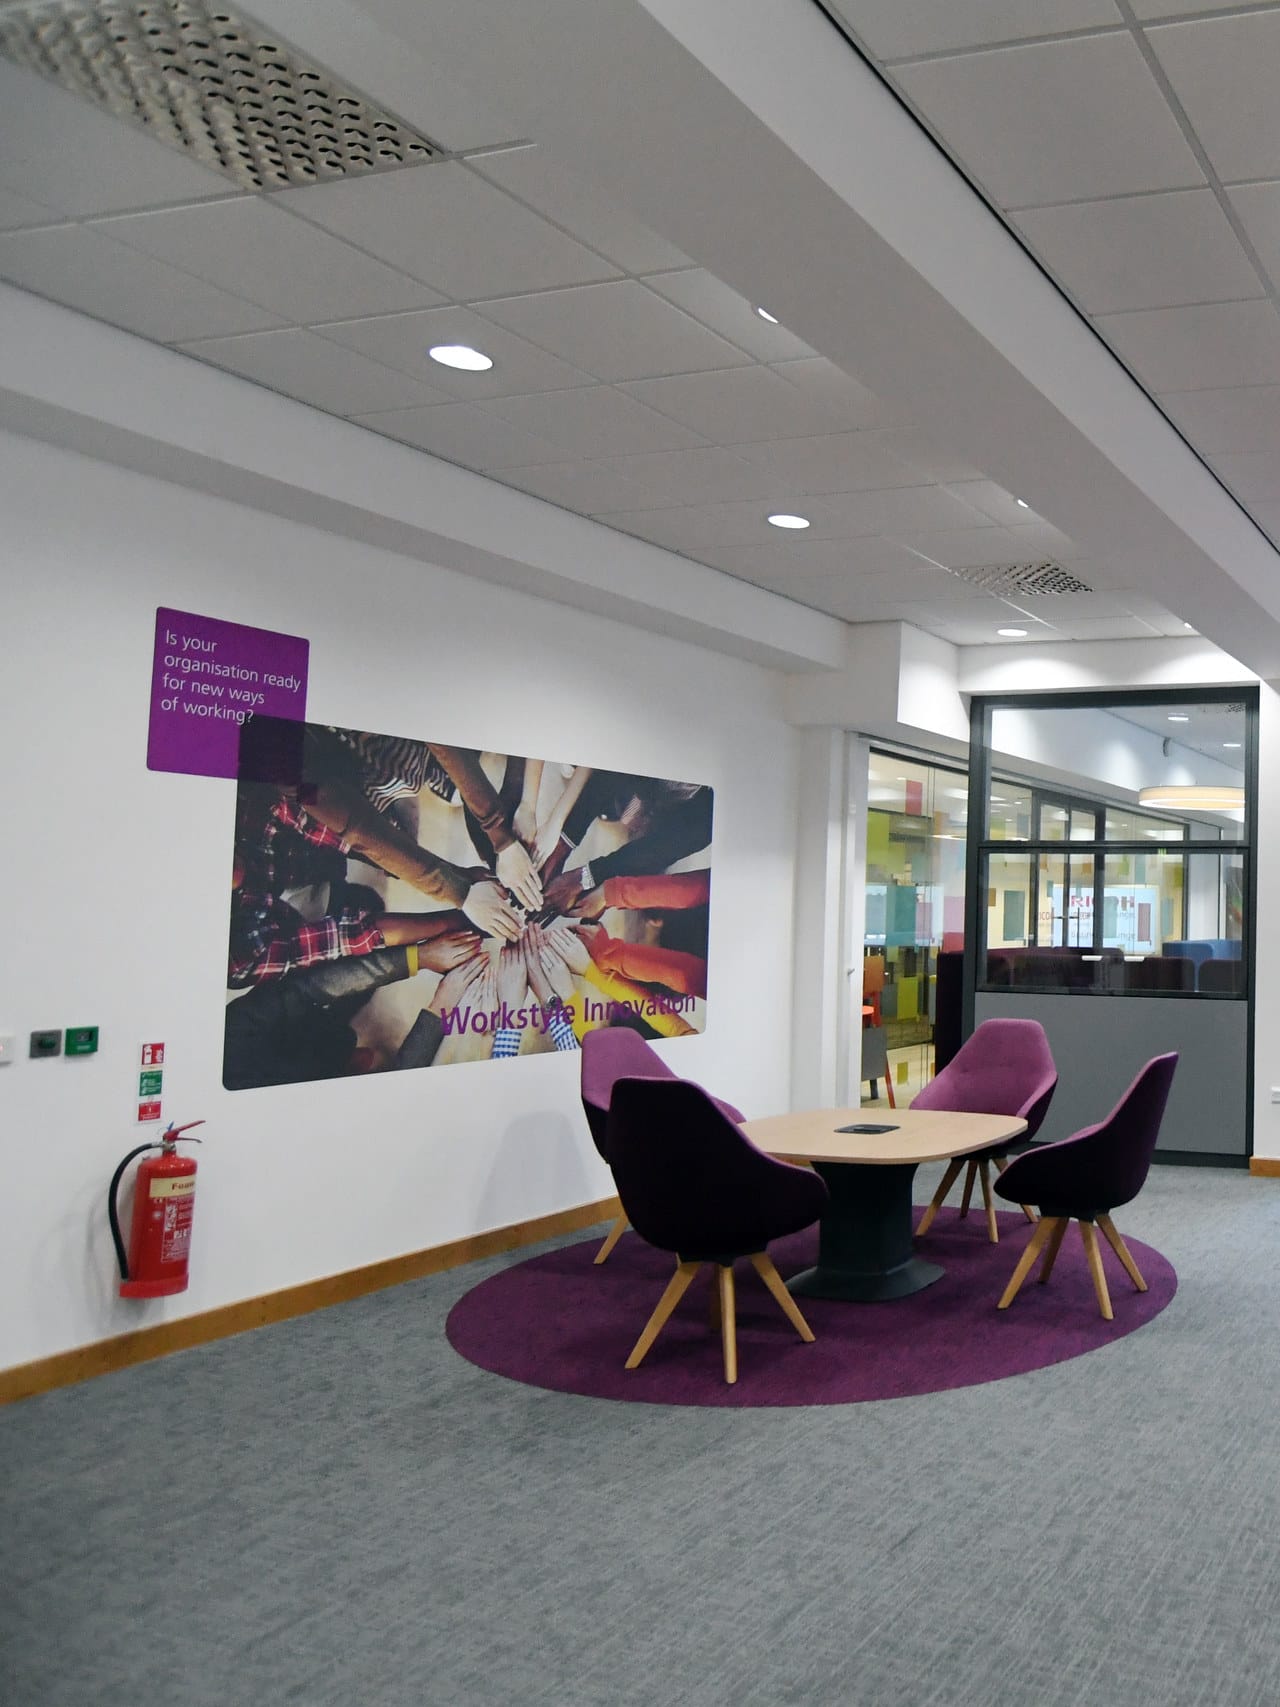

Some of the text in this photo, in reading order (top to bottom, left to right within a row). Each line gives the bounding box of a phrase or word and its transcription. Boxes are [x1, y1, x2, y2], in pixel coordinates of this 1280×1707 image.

[165, 629, 217, 653] Is your
[163, 673, 265, 706] for new ways
[164, 654, 301, 693] organisation ready
[161, 697, 254, 726] of working?
[440, 994, 696, 1036] Workstyle Innovation
